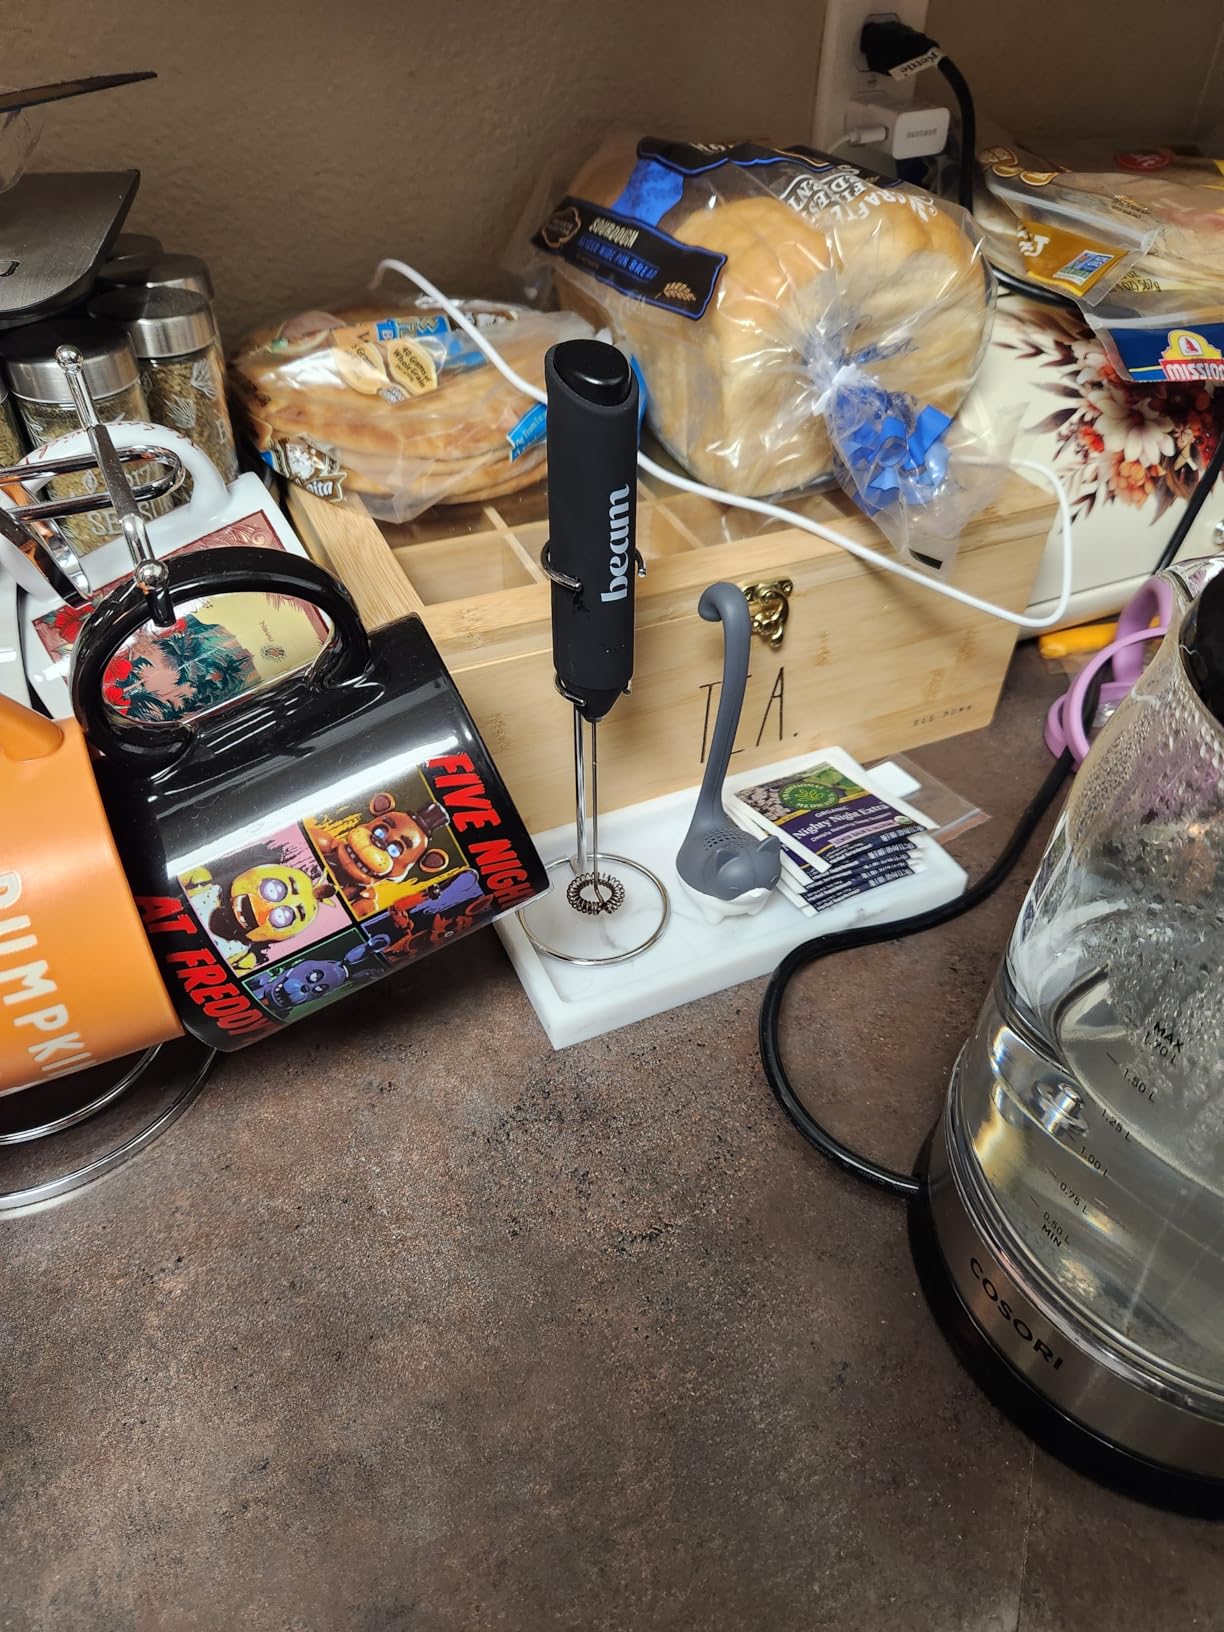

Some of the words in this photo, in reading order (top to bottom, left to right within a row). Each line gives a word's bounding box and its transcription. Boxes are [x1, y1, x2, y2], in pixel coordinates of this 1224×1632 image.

[393, 348, 411, 371] Whole
[411, 368, 426, 389] Grain
[600, 483, 630, 603] beam
[699, 666, 798, 764] TA.
[426, 752, 501, 832] FIVE
[792, 818, 832, 840] Nighty
[830, 810, 861, 823] Night
[858, 803, 890, 816] Extra
[134, 896, 198, 935] AT
[1153, 1021, 1185, 1054] MAX
[1123, 1068, 1147, 1093] 1.50
[1148, 1091, 1156, 1104] L
[1100, 1108, 1123, 1133] 1.25
[1125, 1131, 1133, 1143] L
[1079, 1145, 1102, 1171] 1.00
[1103, 1168, 1111, 1178] L
[1059, 1181, 1082, 1208] 0.75
[1082, 1205, 1090, 1216] L
[1041, 1223, 1062, 1248] MIN
[1043, 1211, 1065, 1236] 0.50
[1064, 1233, 1072, 1245] L
[970, 1257, 1064, 1370] COSORI
